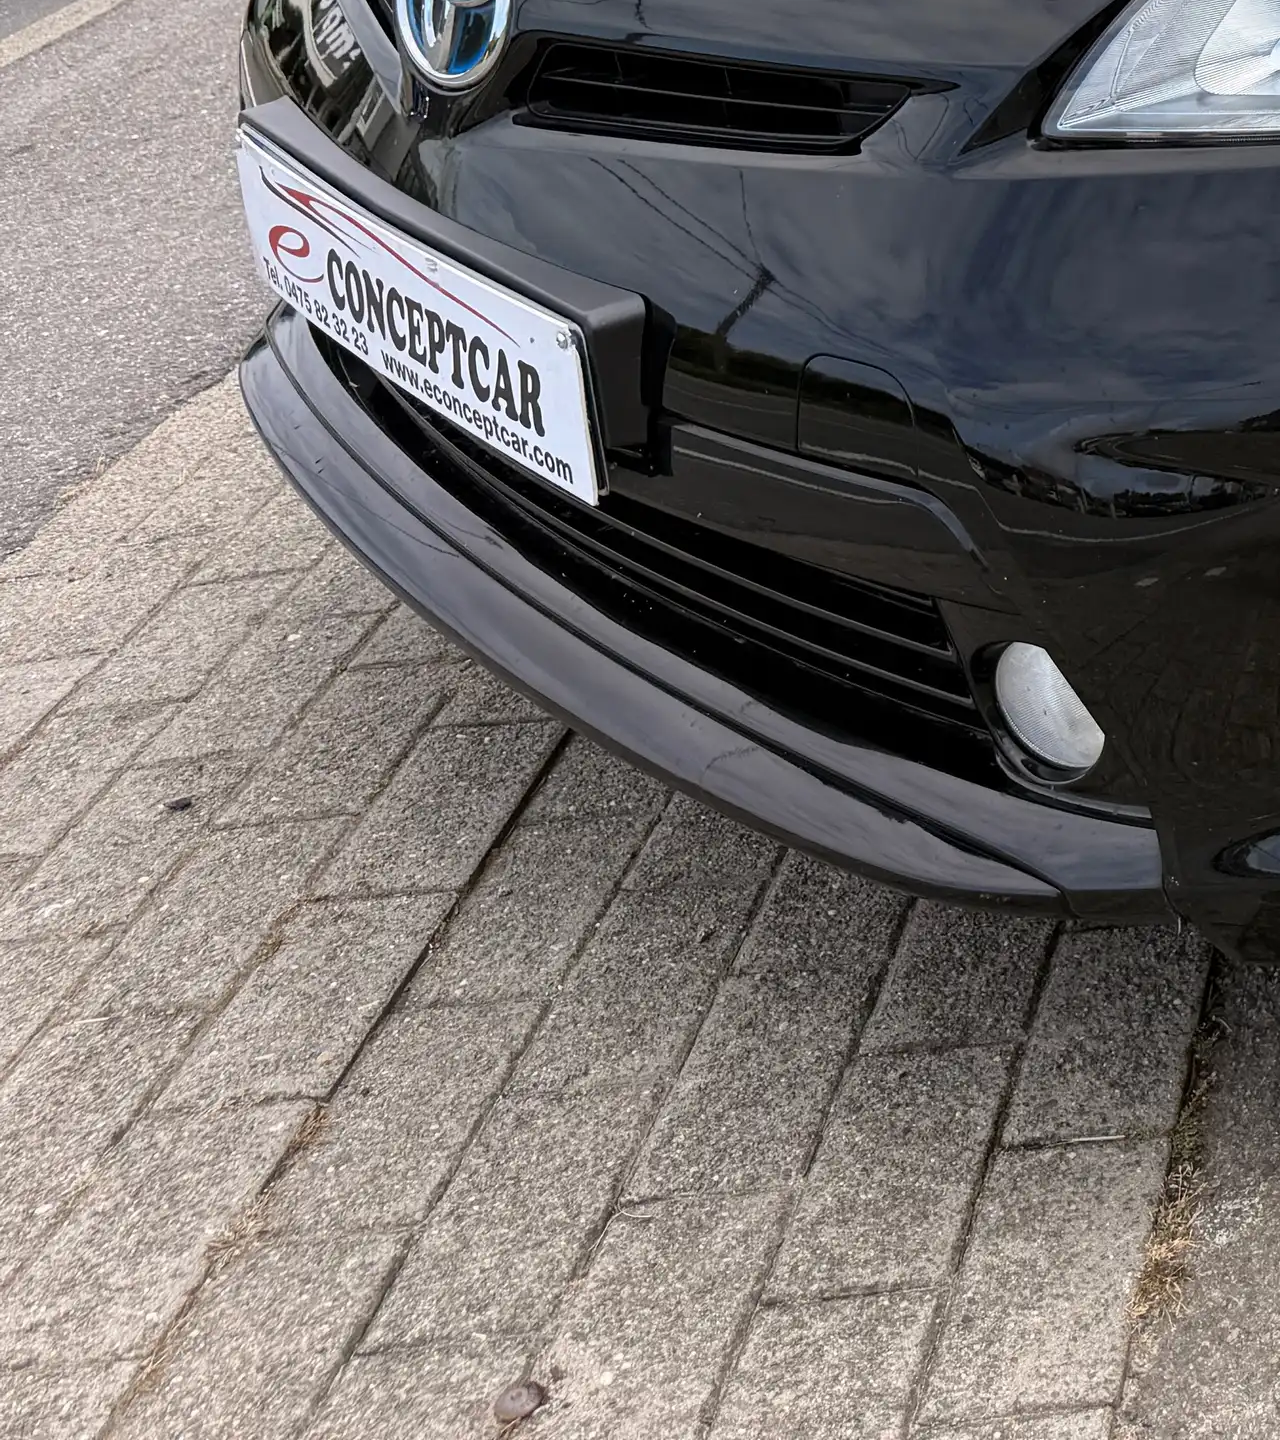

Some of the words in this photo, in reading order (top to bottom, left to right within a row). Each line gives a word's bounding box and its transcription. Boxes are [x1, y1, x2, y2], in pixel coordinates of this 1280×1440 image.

[262, 255, 283, 292] Tel.
[284, 273, 313, 314] 0475
[313, 298, 332, 329] 82
[332, 311, 351, 342] 32
[351, 326, 369, 356] 23
[326, 248, 546, 437] CONCEPTCAR
[381, 349, 575, 486] www.econceptcar.com
